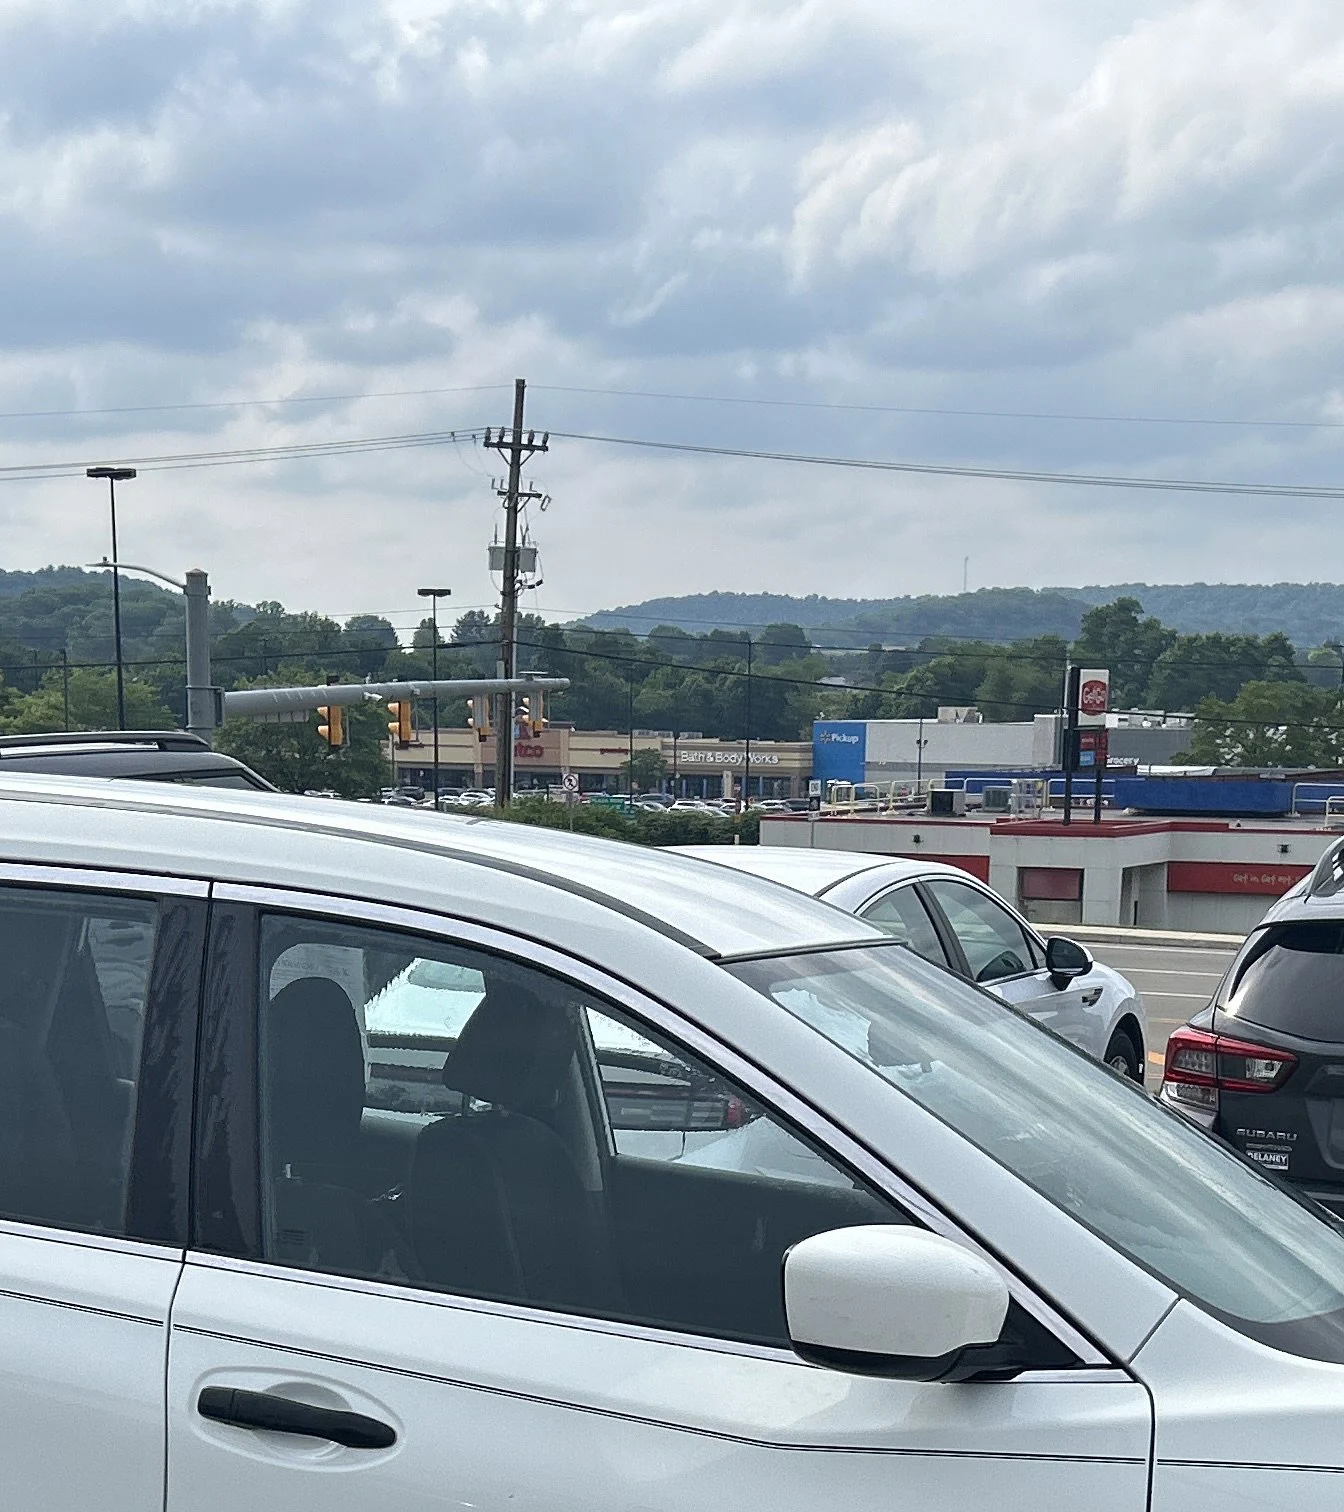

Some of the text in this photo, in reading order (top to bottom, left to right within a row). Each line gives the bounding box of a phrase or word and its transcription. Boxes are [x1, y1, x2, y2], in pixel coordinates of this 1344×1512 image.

[831, 733, 859, 744] Pickup
[514, 742, 544, 757] tco
[681, 751, 704, 763] Bath
[706, 752, 714, 763] &
[715, 752, 743, 765] Body
[1236, 1128, 1297, 1141] SUBARU
